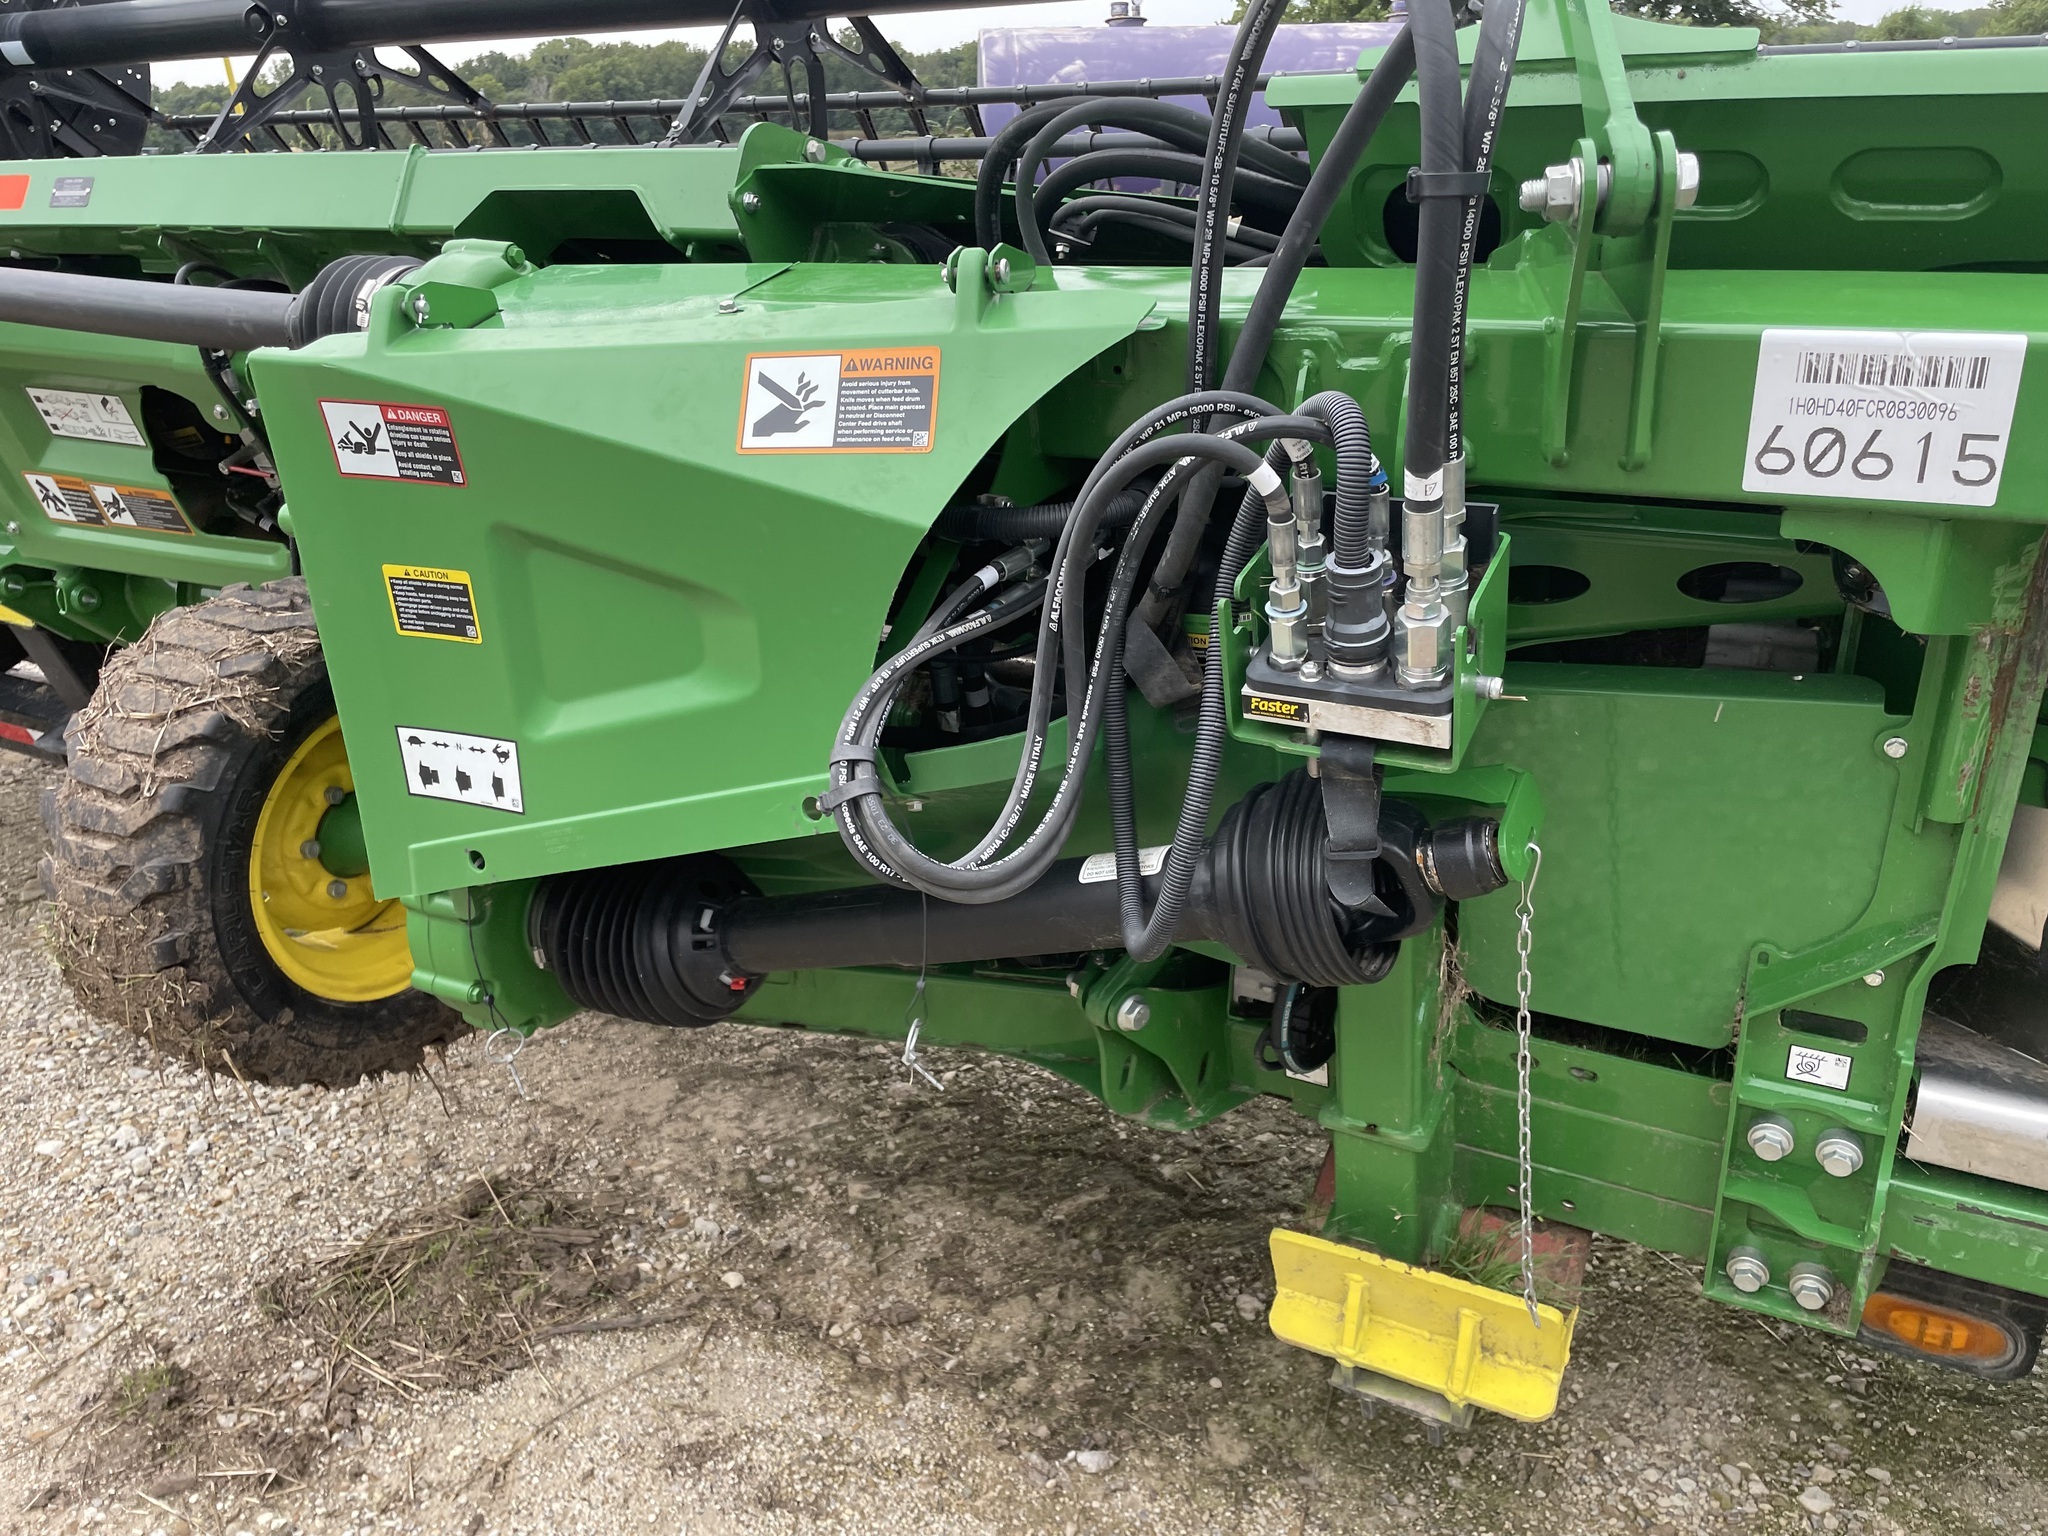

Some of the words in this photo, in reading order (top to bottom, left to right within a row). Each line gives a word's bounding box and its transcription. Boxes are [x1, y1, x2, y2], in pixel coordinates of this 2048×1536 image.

[1241, 0, 1273, 60] LFAGOMMA
[1231, 65, 1244, 90] AT4K
[1488, 97, 1500, 126] 5/8"
[1482, 131, 1492, 154] WP
[1476, 157, 1486, 173] 28
[1209, 187, 1218, 207] 5/8"
[1206, 210, 1215, 226] WP
[1463, 209, 1476, 240] (4000
[1202, 243, 1211, 264] MPa
[1459, 243, 1469, 265] PSI)
[1200, 266, 1209, 291] (4000
[1198, 293, 1207, 311] PSI)
[1453, 268, 1466, 325] FLEXOPAK
[1196, 314, 1205, 362] FLEXOPAK
[1451, 336, 1460, 348] ST
[860, 356, 933, 371] WARNING
[1450, 351, 1459, 365] EN
[1195, 373, 1202, 385] ST
[1450, 367, 1458, 382] 857
[1450, 386, 1458, 404] 2SC
[398, 410, 441, 423] DANGER
[1789, 397, 1958, 421] 1H0HD40FCR0830096
[387, 424, 422, 432] Entanglement
[1140, 427, 1153, 440] WP
[1154, 420, 1165, 430] 21
[1166, 411, 1188, 423] MPa
[1190, 404, 1214, 414] (3000
[1217, 403, 1235, 411] PSI)
[1450, 412, 1458, 431] SAE
[391, 439, 406, 447] injury
[1754, 425, 2000, 487] 60615
[1158, 467, 1176, 489] AT3K
[946, 617, 986, 637] ALFAGOMMA
[928, 634, 945, 645] AT3K
[895, 642, 930, 668] SUPERTUFF
[881, 669, 891, 678] 1B
[871, 676, 883, 692] 3/8"
[859, 697, 870, 710] WP
[1082, 685, 1093, 719] exceeds
[1250, 697, 1299, 715] Faster
[852, 709, 861, 720] 21
[845, 721, 857, 740] MPa
[1077, 722, 1086, 740] SAE
[1032, 735, 1042, 759] ITALY
[1072, 742, 1080, 756] 100
[1029, 761, 1037, 771] IN
[1067, 757, 1076, 774] R17
[1020, 772, 1034, 798] MADE
[1059, 780, 1068, 792] EN
[999, 805, 1022, 839] IC-152/7
[1034, 824, 1046, 835] DN
[853, 834, 868, 853] SAE
[980, 839, 1002, 861] MSHA
[866, 852, 880, 866] 100
[879, 863, 895, 876] R17
